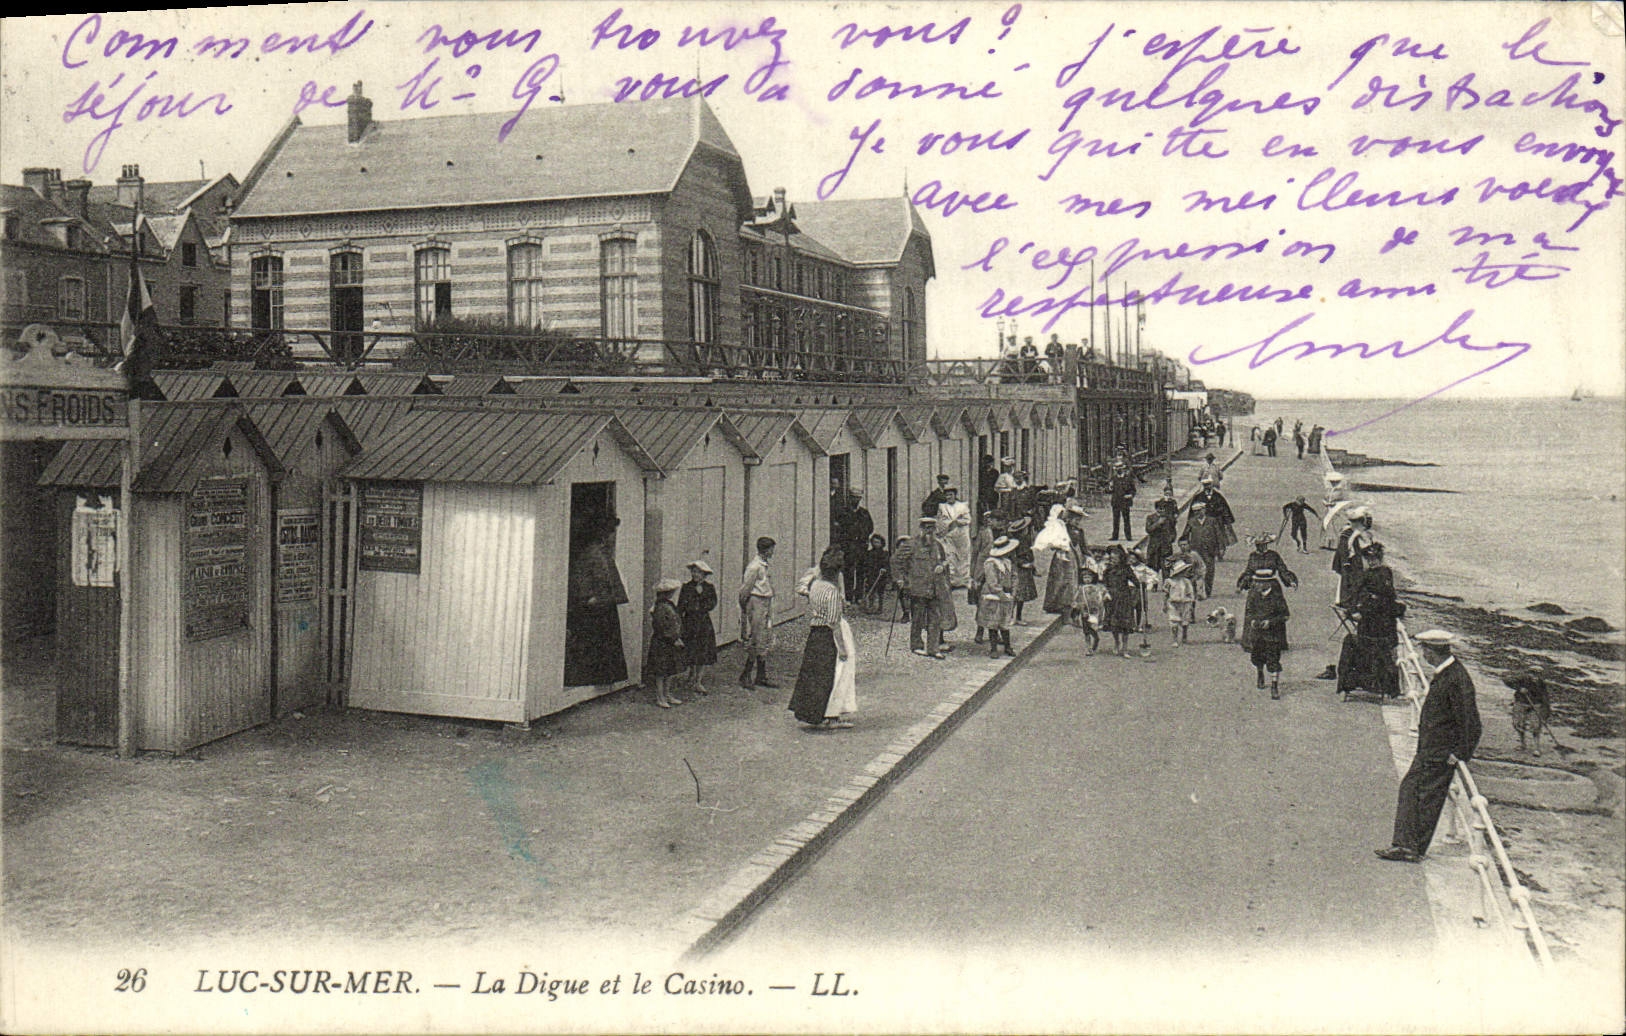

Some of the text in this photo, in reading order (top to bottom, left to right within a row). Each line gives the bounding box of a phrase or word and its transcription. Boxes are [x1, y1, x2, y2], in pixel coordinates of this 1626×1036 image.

[417, 24, 542, 58] vous
[832, 17, 972, 48] vous
[1327, 33, 1450, 90] que
[1502, 17, 1591, 66] le
[613, 73, 730, 102] vous
[1057, 63, 1321, 133] quelques
[916, 128, 1031, 156] vous
[1261, 132, 1319, 158] en
[1348, 133, 1486, 158] vous
[1058, 191, 1152, 218] mes
[36, 389, 115, 425] FROIDS
